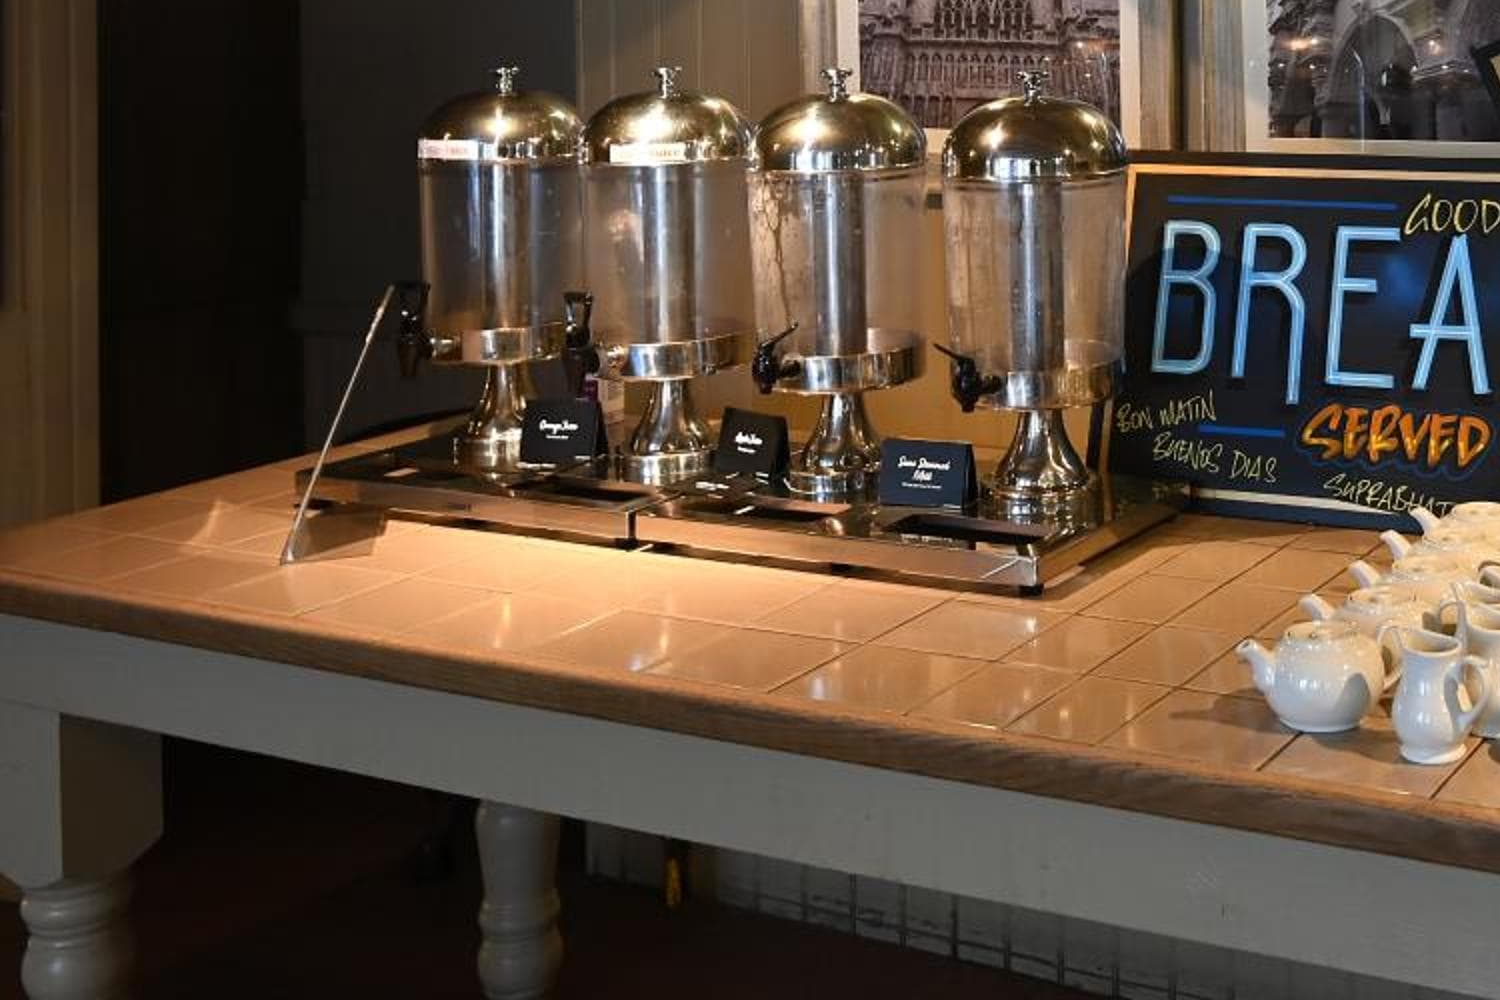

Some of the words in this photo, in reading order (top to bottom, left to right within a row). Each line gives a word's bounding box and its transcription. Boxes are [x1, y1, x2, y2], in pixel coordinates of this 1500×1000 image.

[1116, 401, 1152, 433] BON
[1160, 388, 1216, 426] MATIN
[1302, 402, 1492, 468] SERVED
[1152, 431, 1222, 474] BUENOS
[1230, 450, 1278, 485] DIAS
